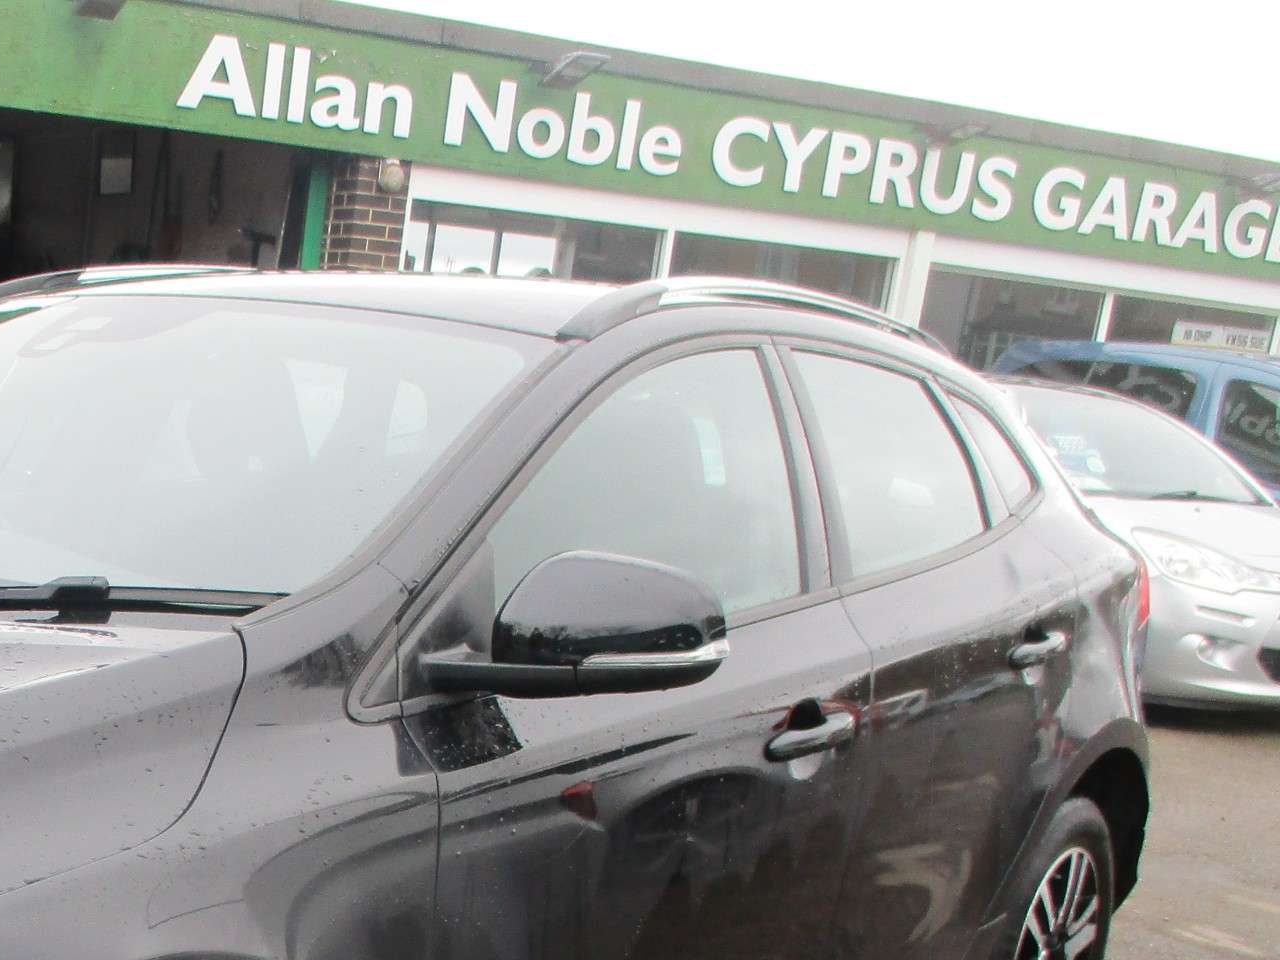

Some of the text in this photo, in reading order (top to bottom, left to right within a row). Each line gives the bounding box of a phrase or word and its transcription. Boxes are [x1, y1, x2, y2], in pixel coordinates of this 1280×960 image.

[175, 33, 414, 139] Allan
[443, 71, 683, 176] Noble
[711, 116, 1018, 223] CYPRUS
